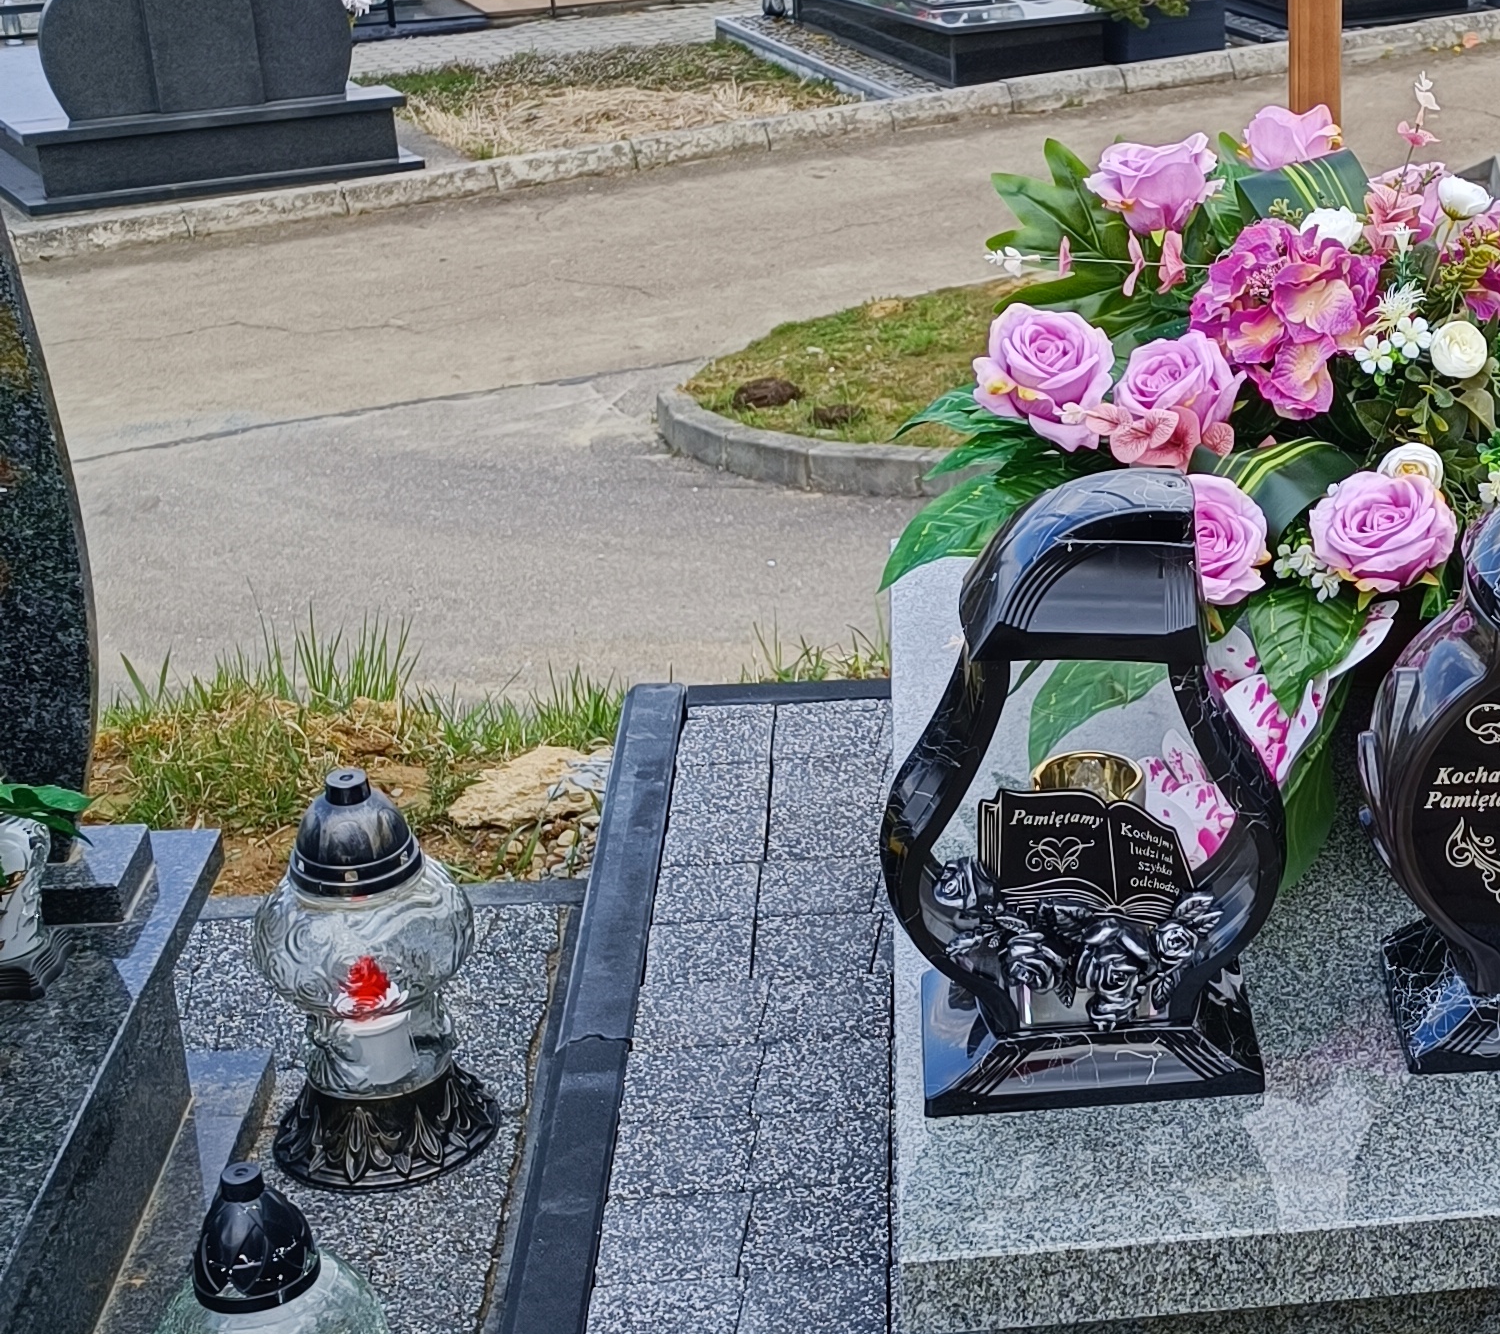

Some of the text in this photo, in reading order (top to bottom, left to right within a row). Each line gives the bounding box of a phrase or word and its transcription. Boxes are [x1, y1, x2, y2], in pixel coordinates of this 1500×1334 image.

[1009, 809, 1104, 830] Pamiętamy
[1120, 822, 1174, 851] Kochajmy
[1130, 842, 1159, 861] ludzi
[1138, 860, 1173, 876] szybko
